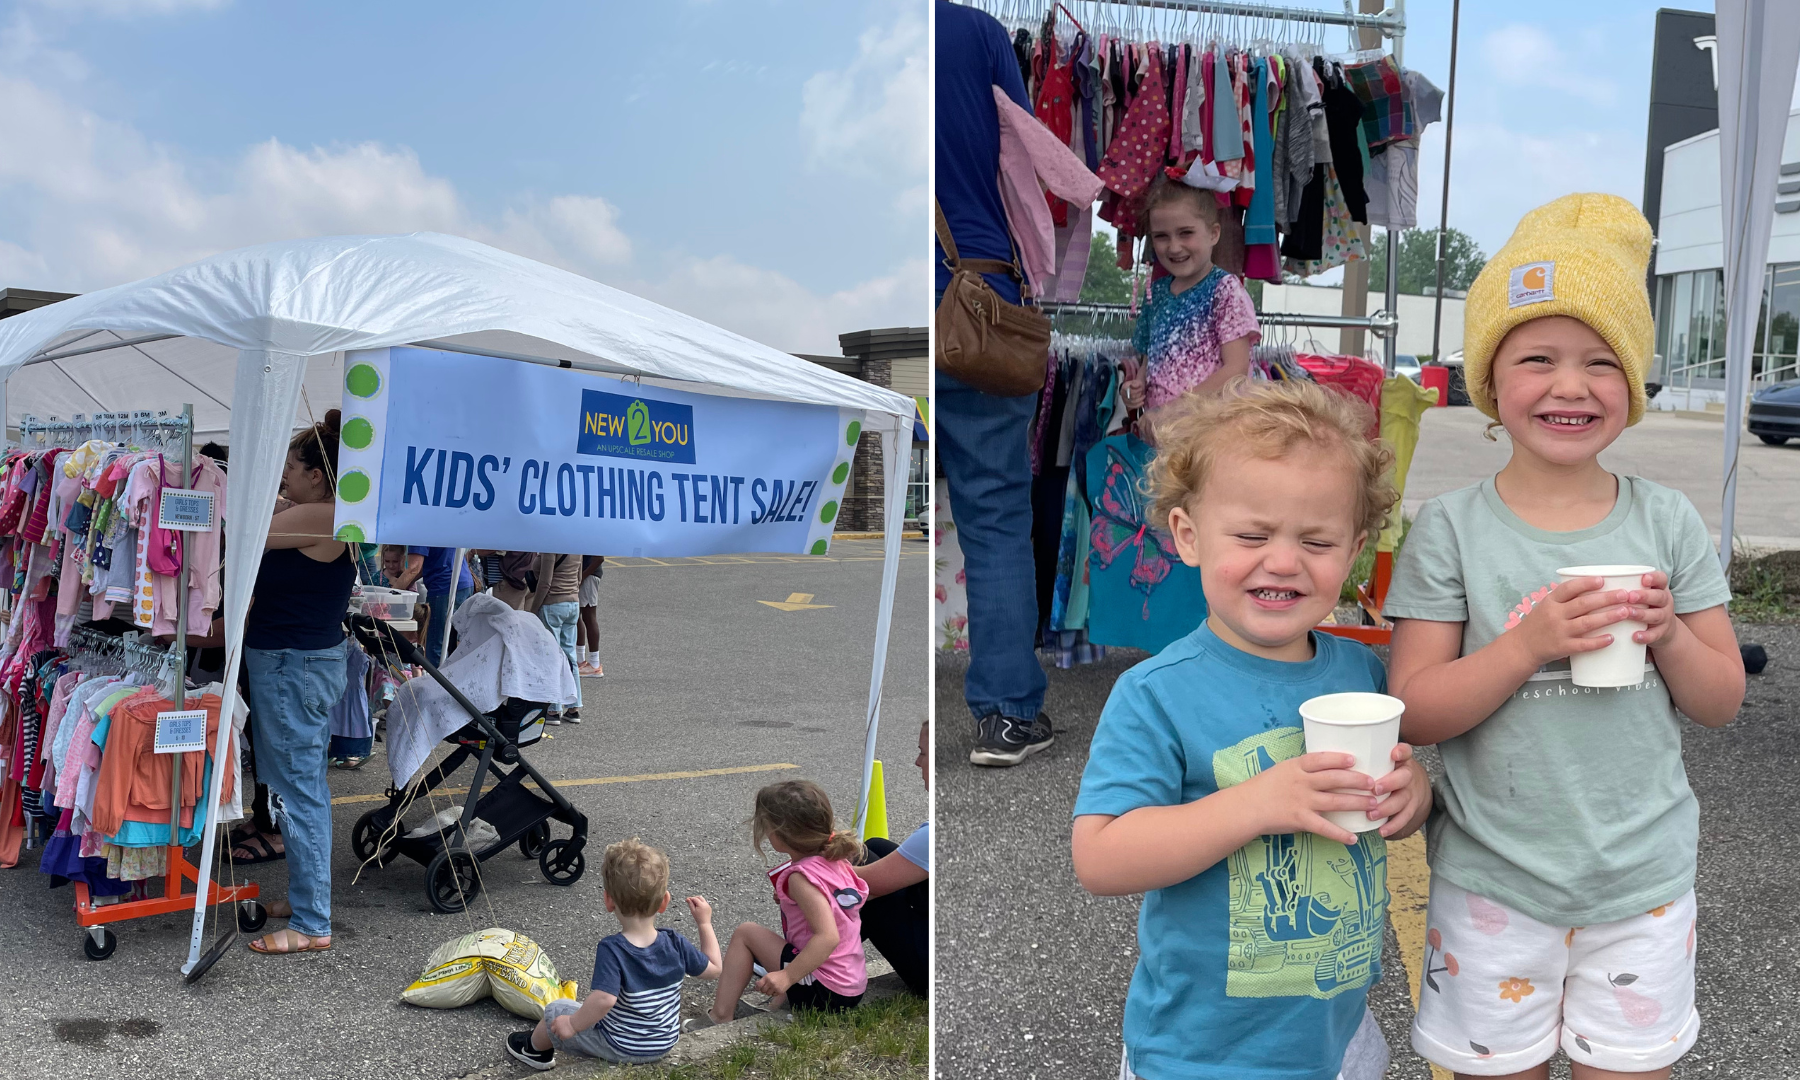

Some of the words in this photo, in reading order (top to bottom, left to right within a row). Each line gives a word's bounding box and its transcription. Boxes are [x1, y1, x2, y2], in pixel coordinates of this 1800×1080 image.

[1516, 289, 1545, 299] carhartt
[158, 410, 168, 418] 3M
[584, 411, 625, 438] NEW
[631, 408, 648, 441] 2
[652, 420, 688, 446] YOU
[596, 444, 607, 452] AN
[608, 445, 635, 456] UPSCALE
[636, 447, 658, 458] RESALE
[658, 450, 675, 459] SHOP
[402, 446, 511, 512] KIDS'
[518, 458, 666, 522] CLOTHING
[671, 472, 745, 525] TENT
[750, 477, 818, 525] SALE!
[1513, 684, 1600, 700] reschool
[499, 966, 528, 989] SAND
